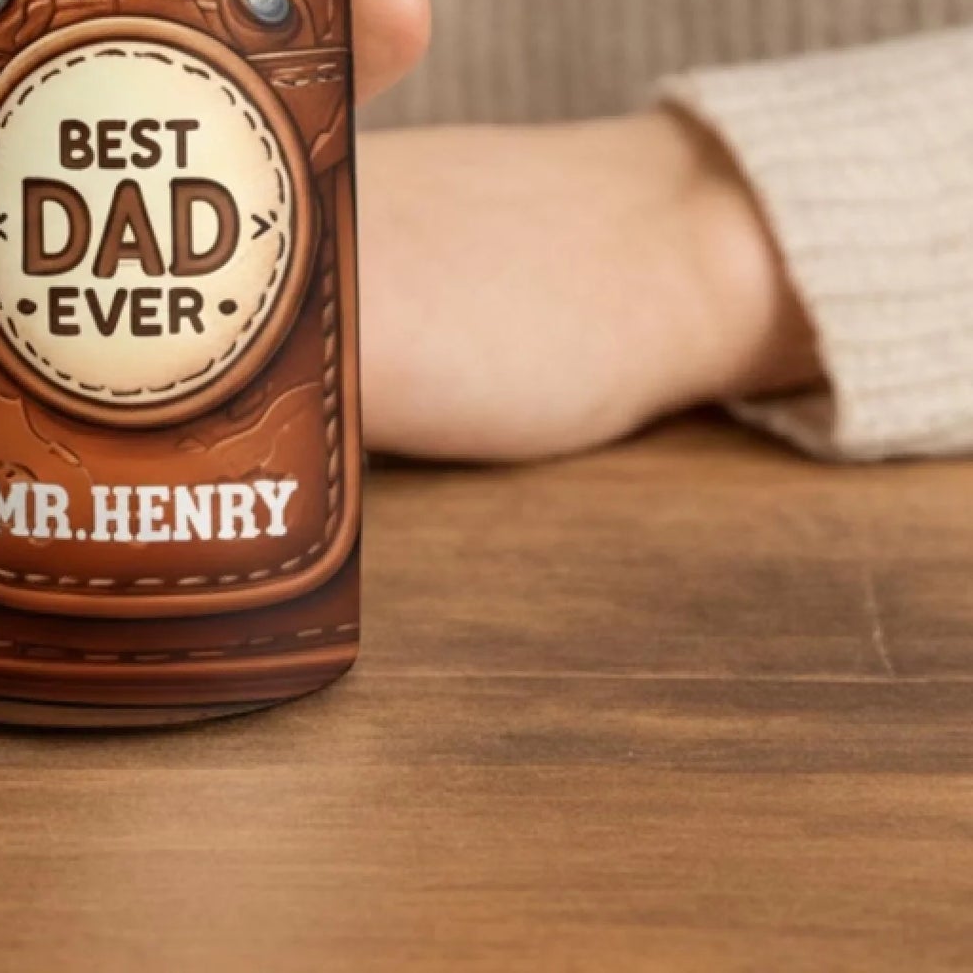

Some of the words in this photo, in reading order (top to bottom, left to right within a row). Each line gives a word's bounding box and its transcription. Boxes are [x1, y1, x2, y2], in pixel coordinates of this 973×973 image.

[58, 119, 200, 169] BEST
[21, 177, 241, 280] DAD
[49, 286, 204, 337] EVER
